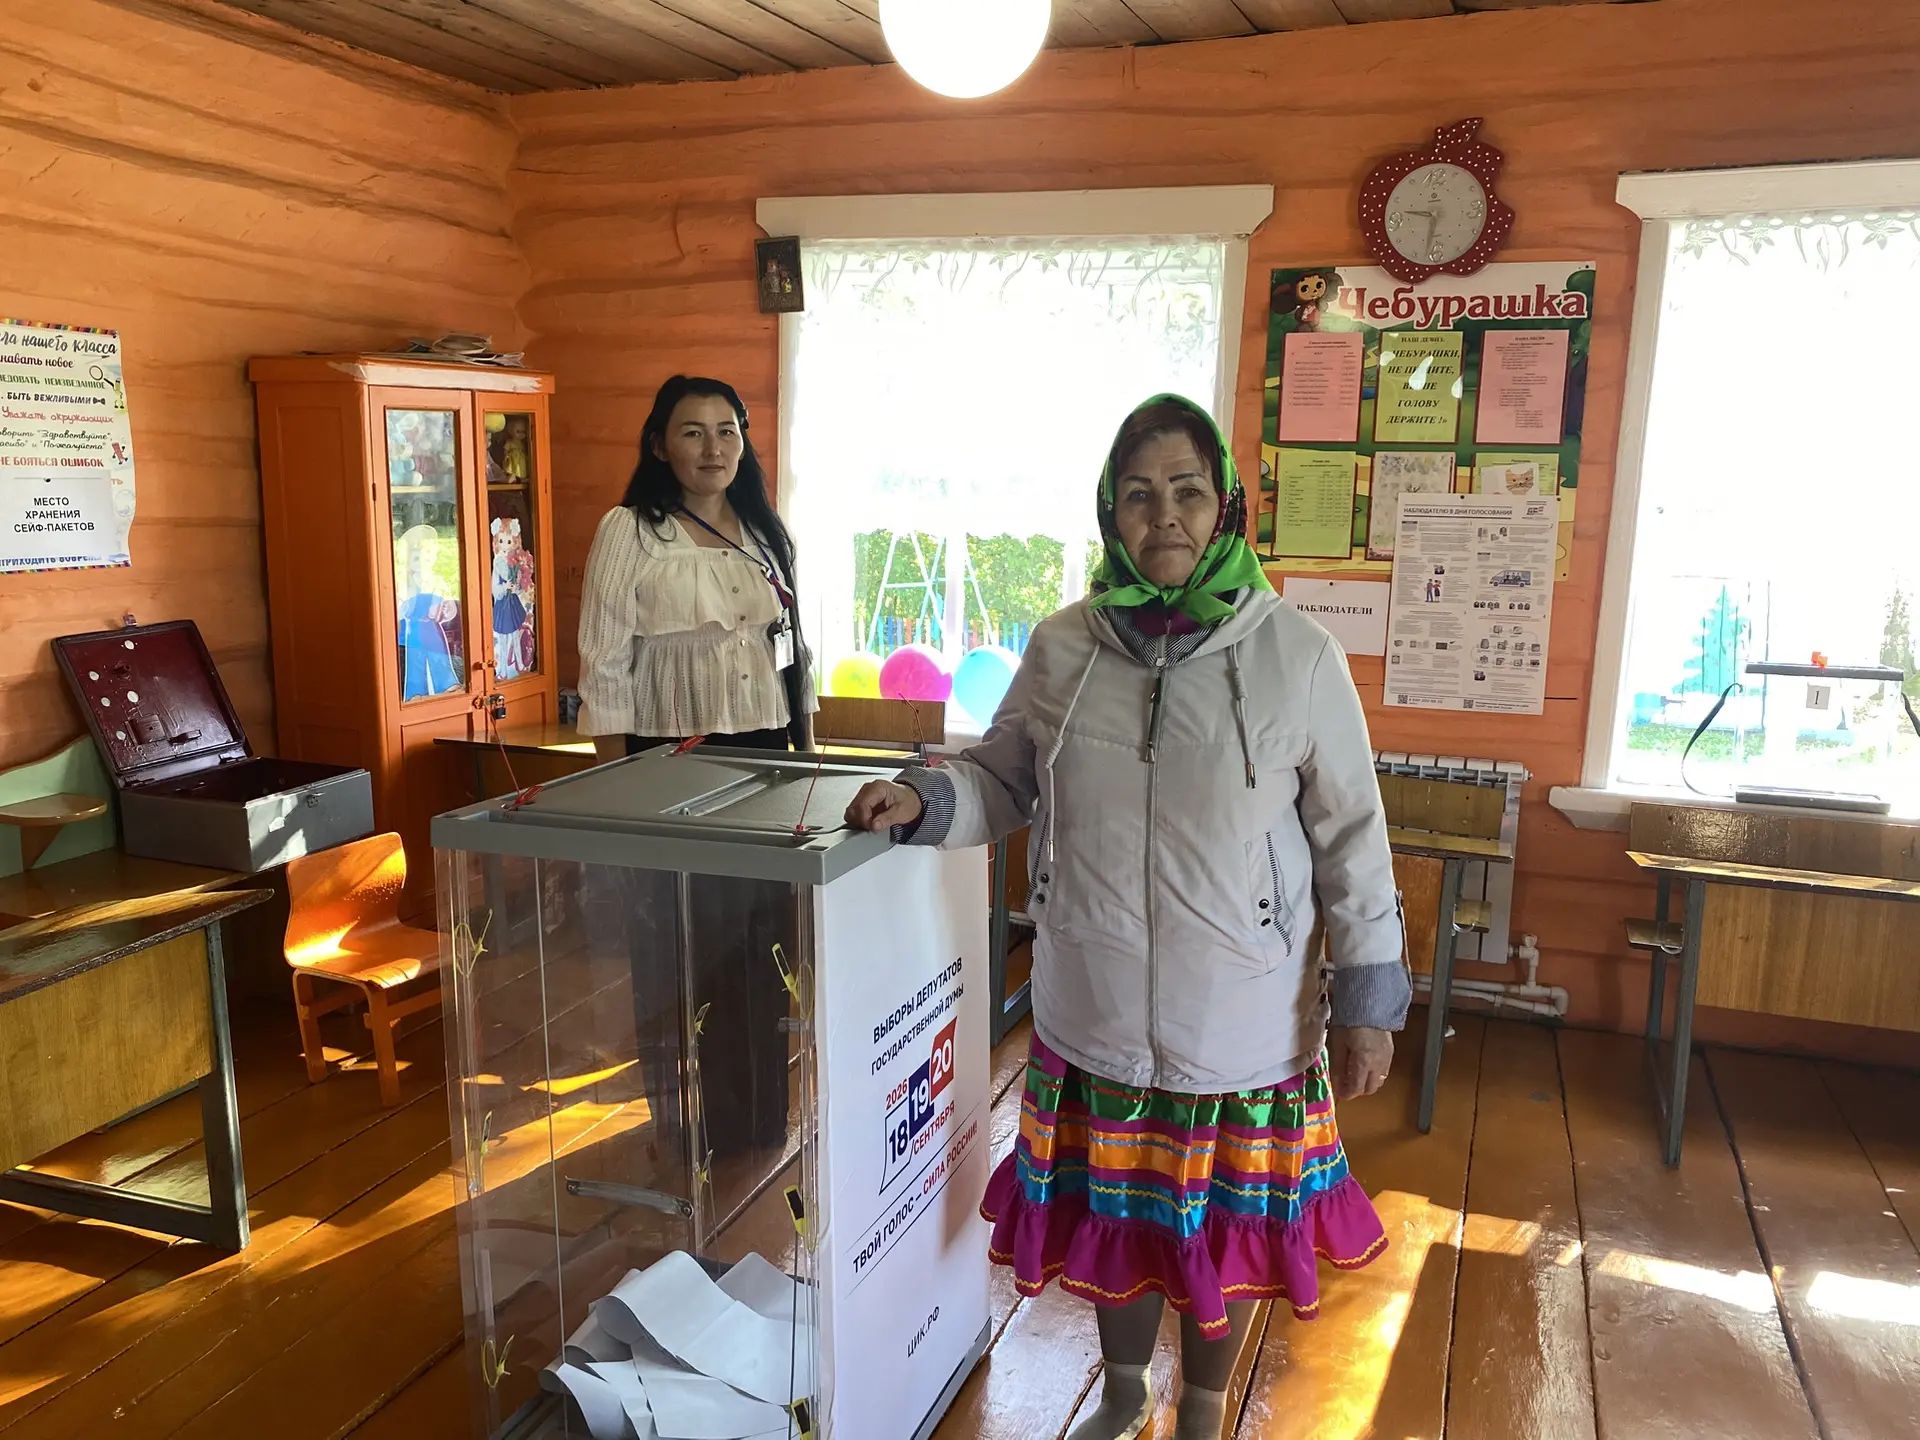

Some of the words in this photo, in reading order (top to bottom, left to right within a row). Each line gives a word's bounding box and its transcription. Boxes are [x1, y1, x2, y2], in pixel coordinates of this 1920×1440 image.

[1340, 284, 1587, 328] Чебурашка
[0, 331, 17, 345] ла
[73, 339, 117, 354] класса
[45, 355, 75, 368] новое
[1387, 366, 1402, 374] НЕ
[7, 392, 31, 401] БЫТЬ
[34, 393, 91, 404] ВЕЖЛИВЫМИ
[13, 456, 58, 467] БОЯТЬСЯ
[60, 457, 104, 468] ОШИБОК
[34, 497, 69, 506] МЕСТО
[25, 510, 80, 519] ХРАНЕНИЯ
[14, 522, 95, 533] СЕЙФ-ПАКЕТОВ
[1296, 604, 1373, 615] НАБЛЮДАТЕЛИ
[873, 997, 914, 1044] ВЫБОРЫ
[916, 957, 962, 1010] ДЕПУТАТОВ
[871, 999, 944, 1076] ГОСУДАРСТВЕННОЙ
[944, 982, 964, 1012] ДУМЫ
[886, 1078, 908, 1110] 2026
[889, 1119, 908, 1164] 18
[911, 1078, 929, 1122] 19
[932, 1038, 952, 1085] 20
[913, 1100, 955, 1155] СЕНТЯБРЯ
[853, 1229, 881, 1273] ТВОЙ
[883, 1197, 914, 1242] ГОЛОС
[923, 1161, 945, 1195] СИЛА
[946, 1119, 978, 1169] РОССИИ!
[907, 1306, 940, 1358] ЦИК.РФ
